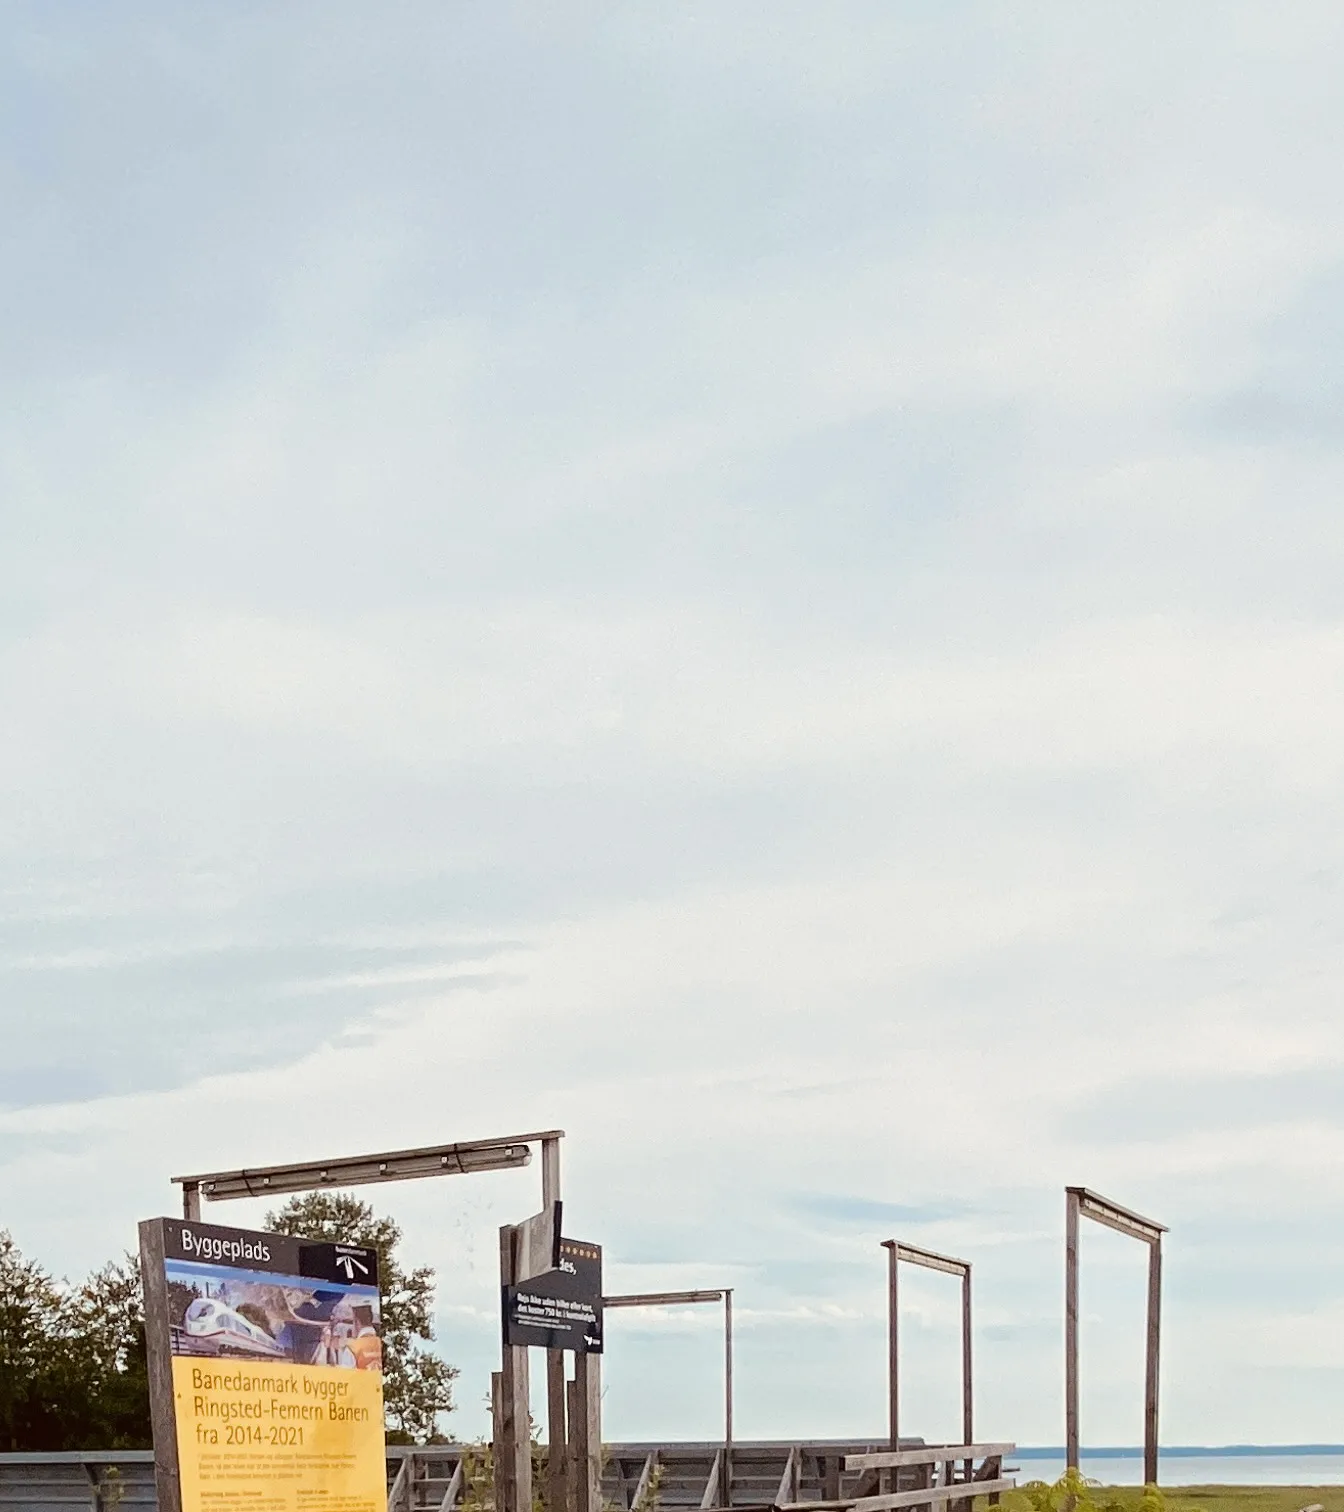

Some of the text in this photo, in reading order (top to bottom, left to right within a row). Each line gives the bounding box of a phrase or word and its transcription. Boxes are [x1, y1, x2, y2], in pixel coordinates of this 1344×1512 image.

[181, 1229, 271, 1262] Byggeplads
[192, 1368, 349, 1400] Banedanmark bygger
[193, 1396, 369, 1423] Ringsted-Femern Banen
[196, 1424, 304, 1446] fra 2014-2021
